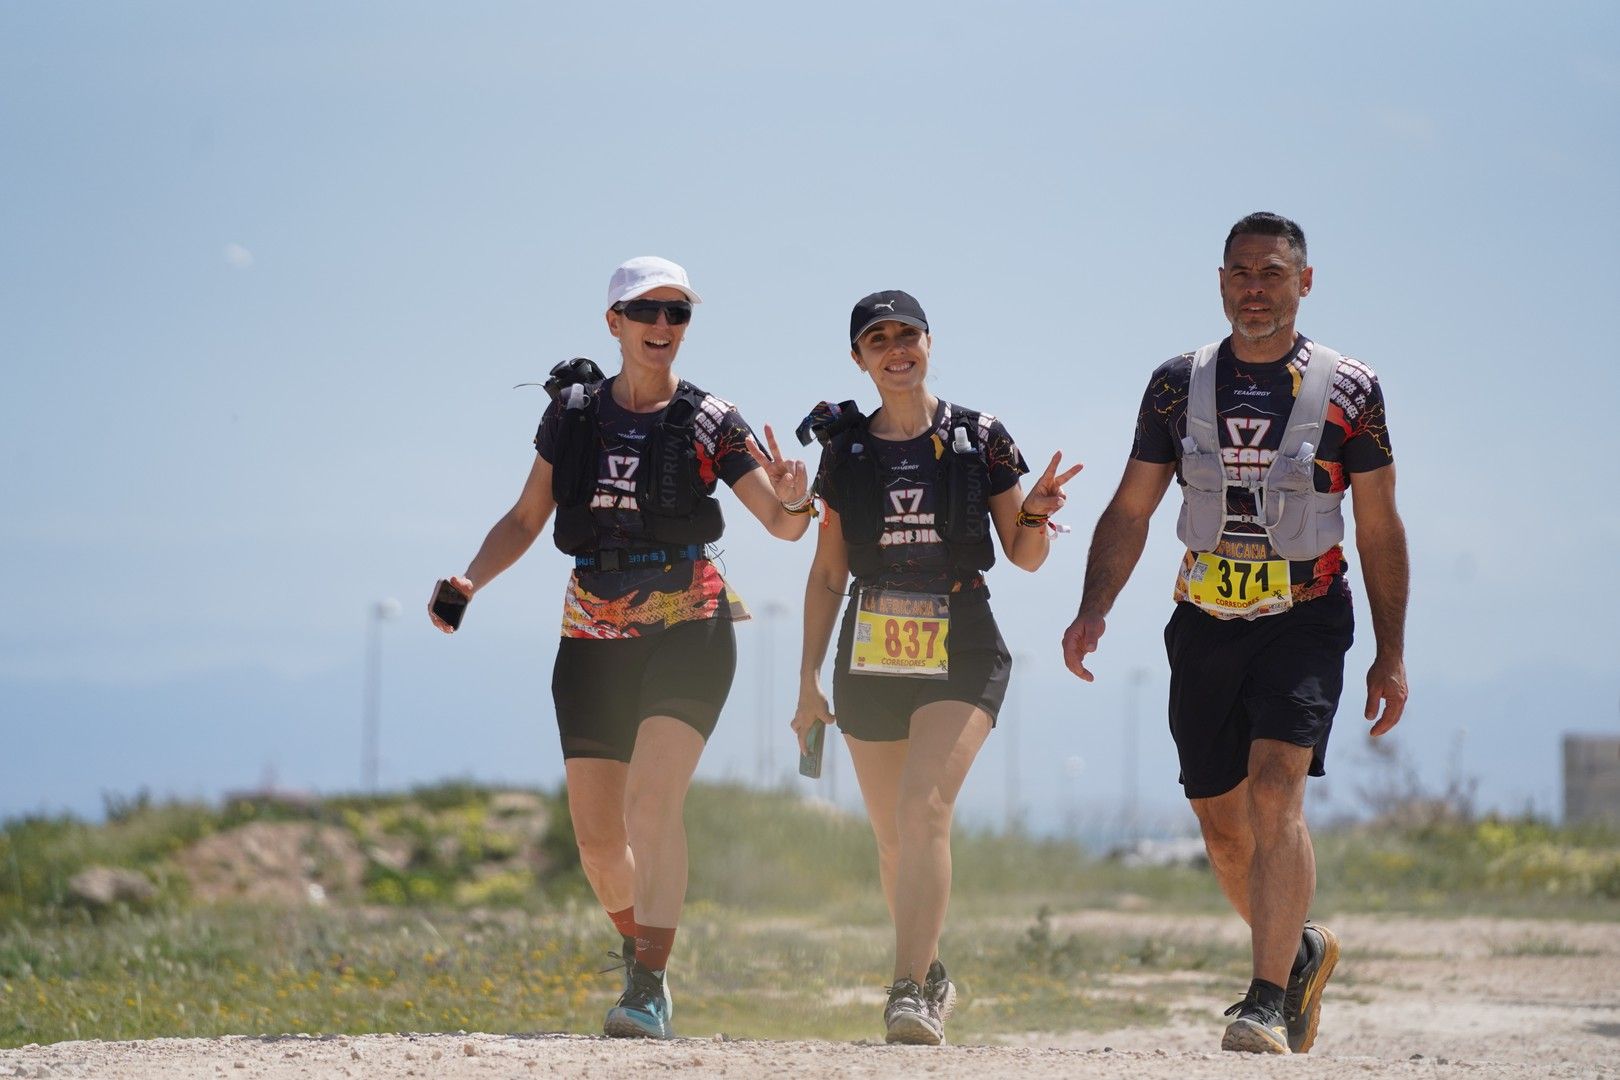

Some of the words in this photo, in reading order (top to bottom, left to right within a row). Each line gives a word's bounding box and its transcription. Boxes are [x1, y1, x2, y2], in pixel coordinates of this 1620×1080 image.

[661, 435, 683, 508] KIPRUN
[966, 464, 981, 538] KIPRUN
[1217, 560, 1269, 600] 371
[1216, 596, 1260, 608] CORREDORES
[885, 619, 940, 659] 837
[881, 658, 926, 667] CORREDORES
